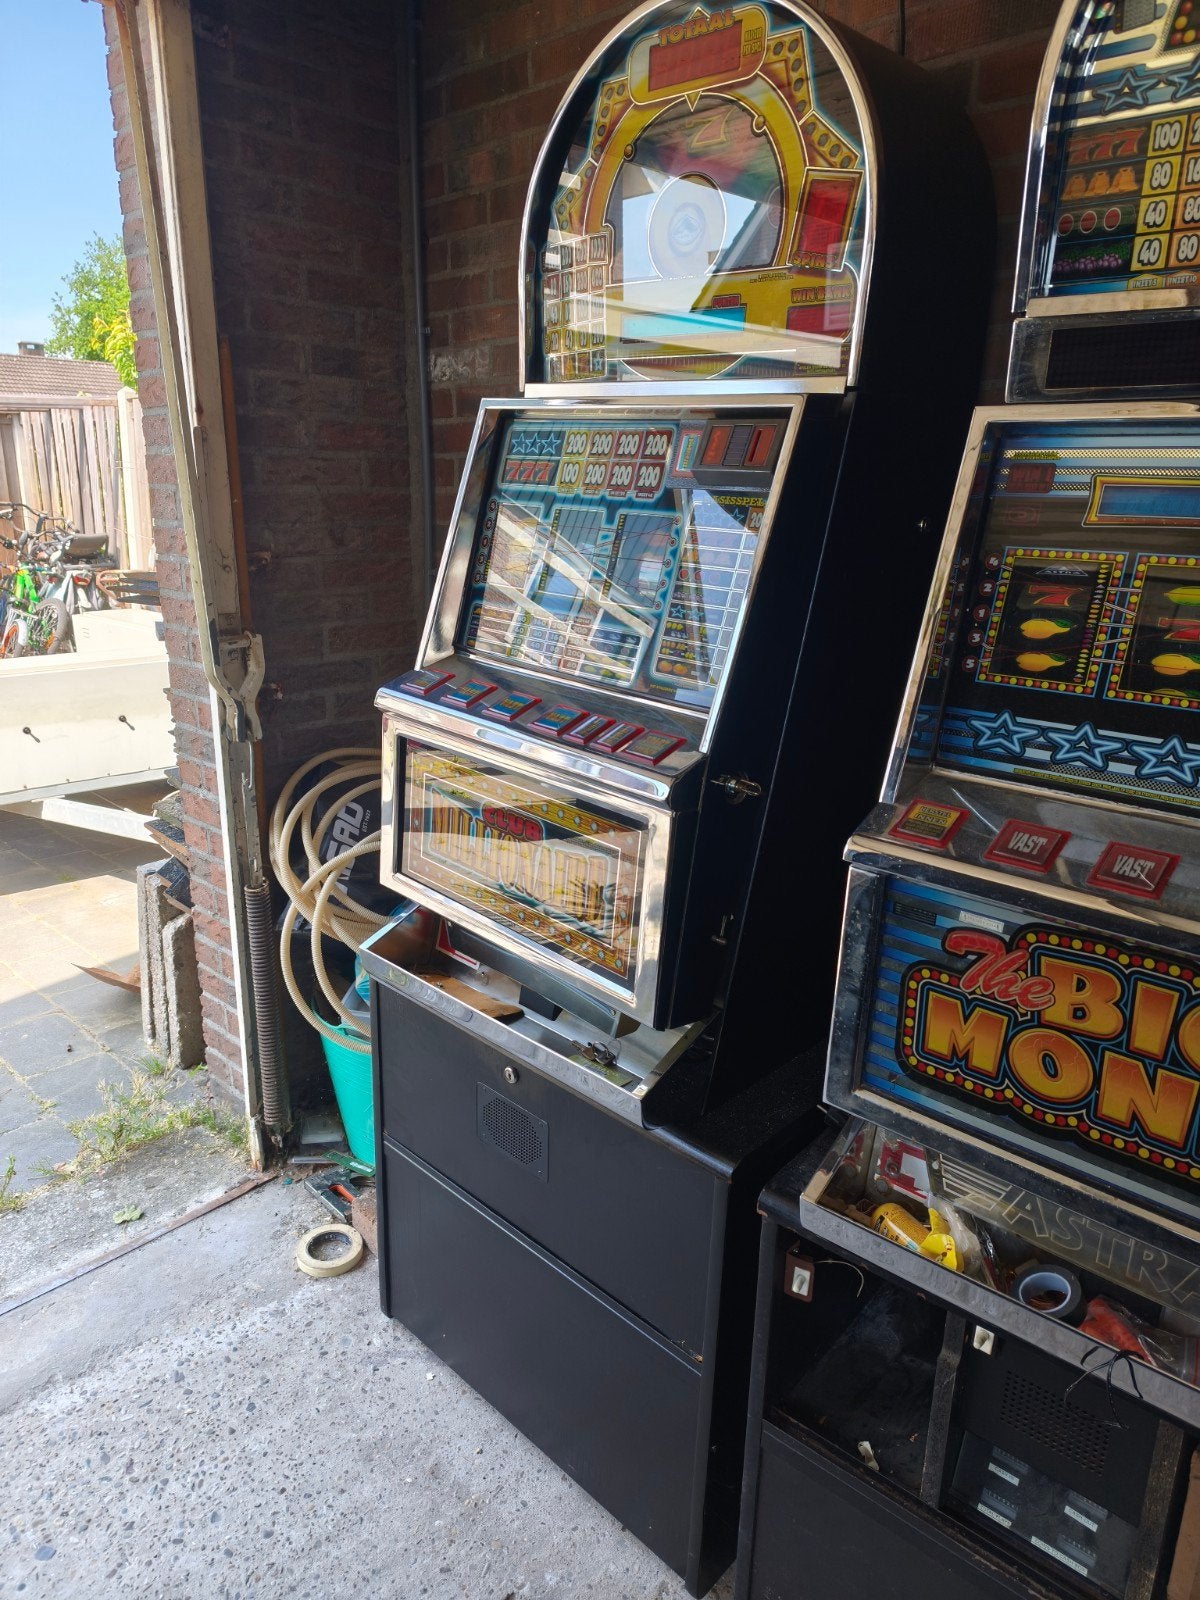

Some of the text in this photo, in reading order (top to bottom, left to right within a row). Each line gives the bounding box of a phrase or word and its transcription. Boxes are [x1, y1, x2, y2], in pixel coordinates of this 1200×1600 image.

[658, 8, 735, 46] TOTAAL
[1153, 121, 1182, 150] 100
[1151, 161, 1173, 190] 80
[1144, 201, 1167, 228] 40
[1138, 238, 1161, 266] 40
[1177, 234, 1200, 262] 80
[567, 433, 587, 455] 200
[590, 433, 612, 455] 200
[617, 434, 639, 455] 200
[644, 434, 667, 456] 200
[561, 462, 580, 484] 100
[584, 463, 606, 485] 200
[611, 464, 632, 486] 200
[637, 465, 661, 488] 200
[482, 804, 544, 843] CLUB
[1007, 830, 1047, 855] VAST
[1113, 853, 1155, 878] VAST
[943, 929, 1056, 1012] The
